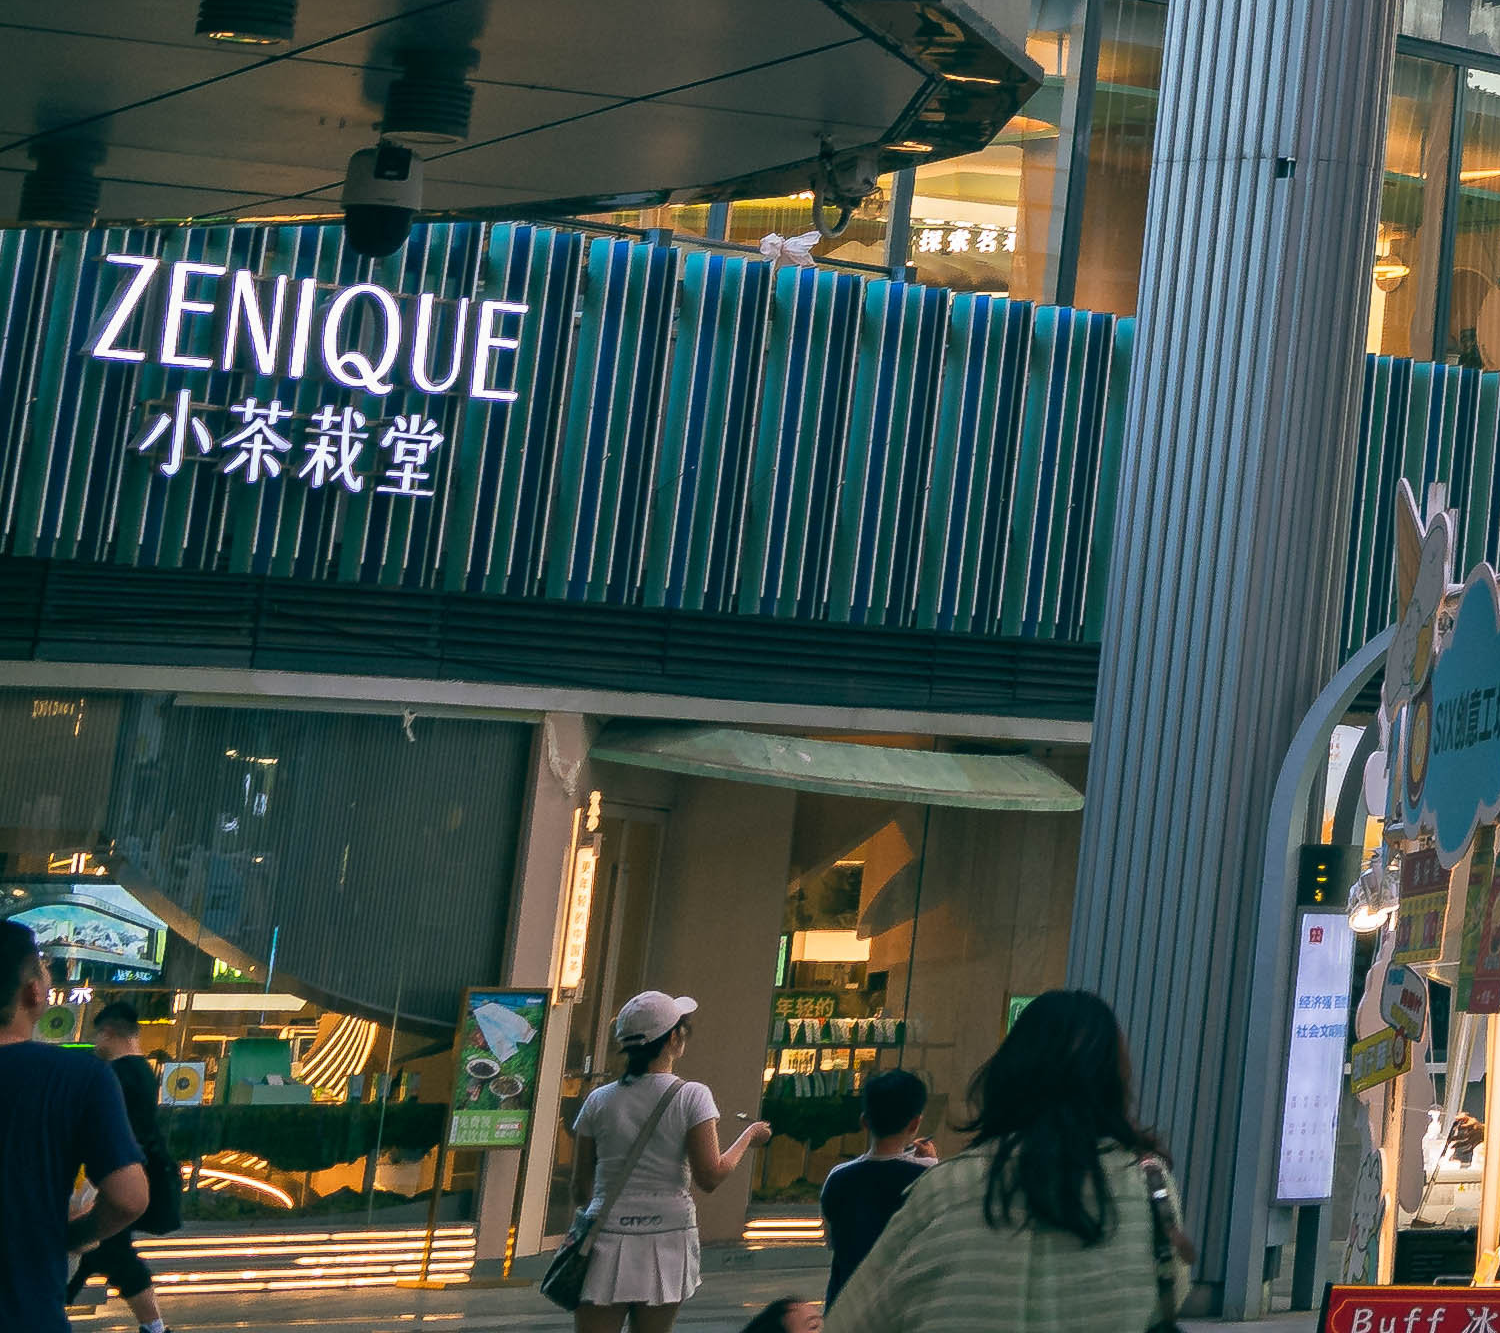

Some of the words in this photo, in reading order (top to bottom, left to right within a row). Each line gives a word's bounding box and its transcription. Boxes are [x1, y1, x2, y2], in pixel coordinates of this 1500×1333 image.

[93, 252, 529, 402] ZENIQUE
[138, 389, 444, 496] 小茶栽堂
[1351, 1306, 1446, 1333] Buff
